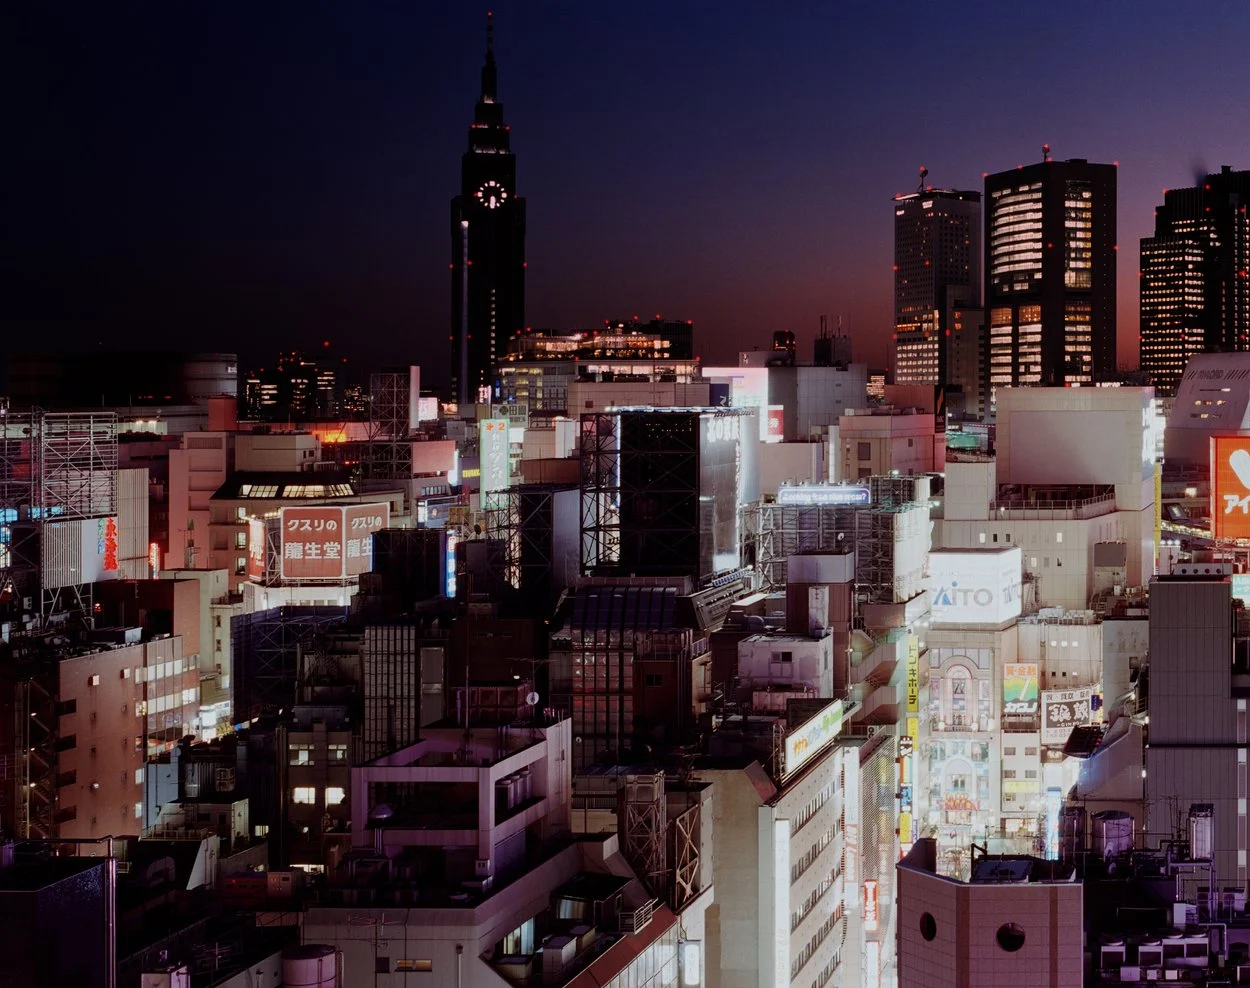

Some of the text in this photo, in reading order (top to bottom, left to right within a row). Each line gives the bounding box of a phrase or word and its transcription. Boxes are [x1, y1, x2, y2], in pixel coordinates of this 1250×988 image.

[287, 519, 338, 532] クスリの
[351, 516, 383, 530] クスリの
[284, 541, 341, 560] 龍生堂
